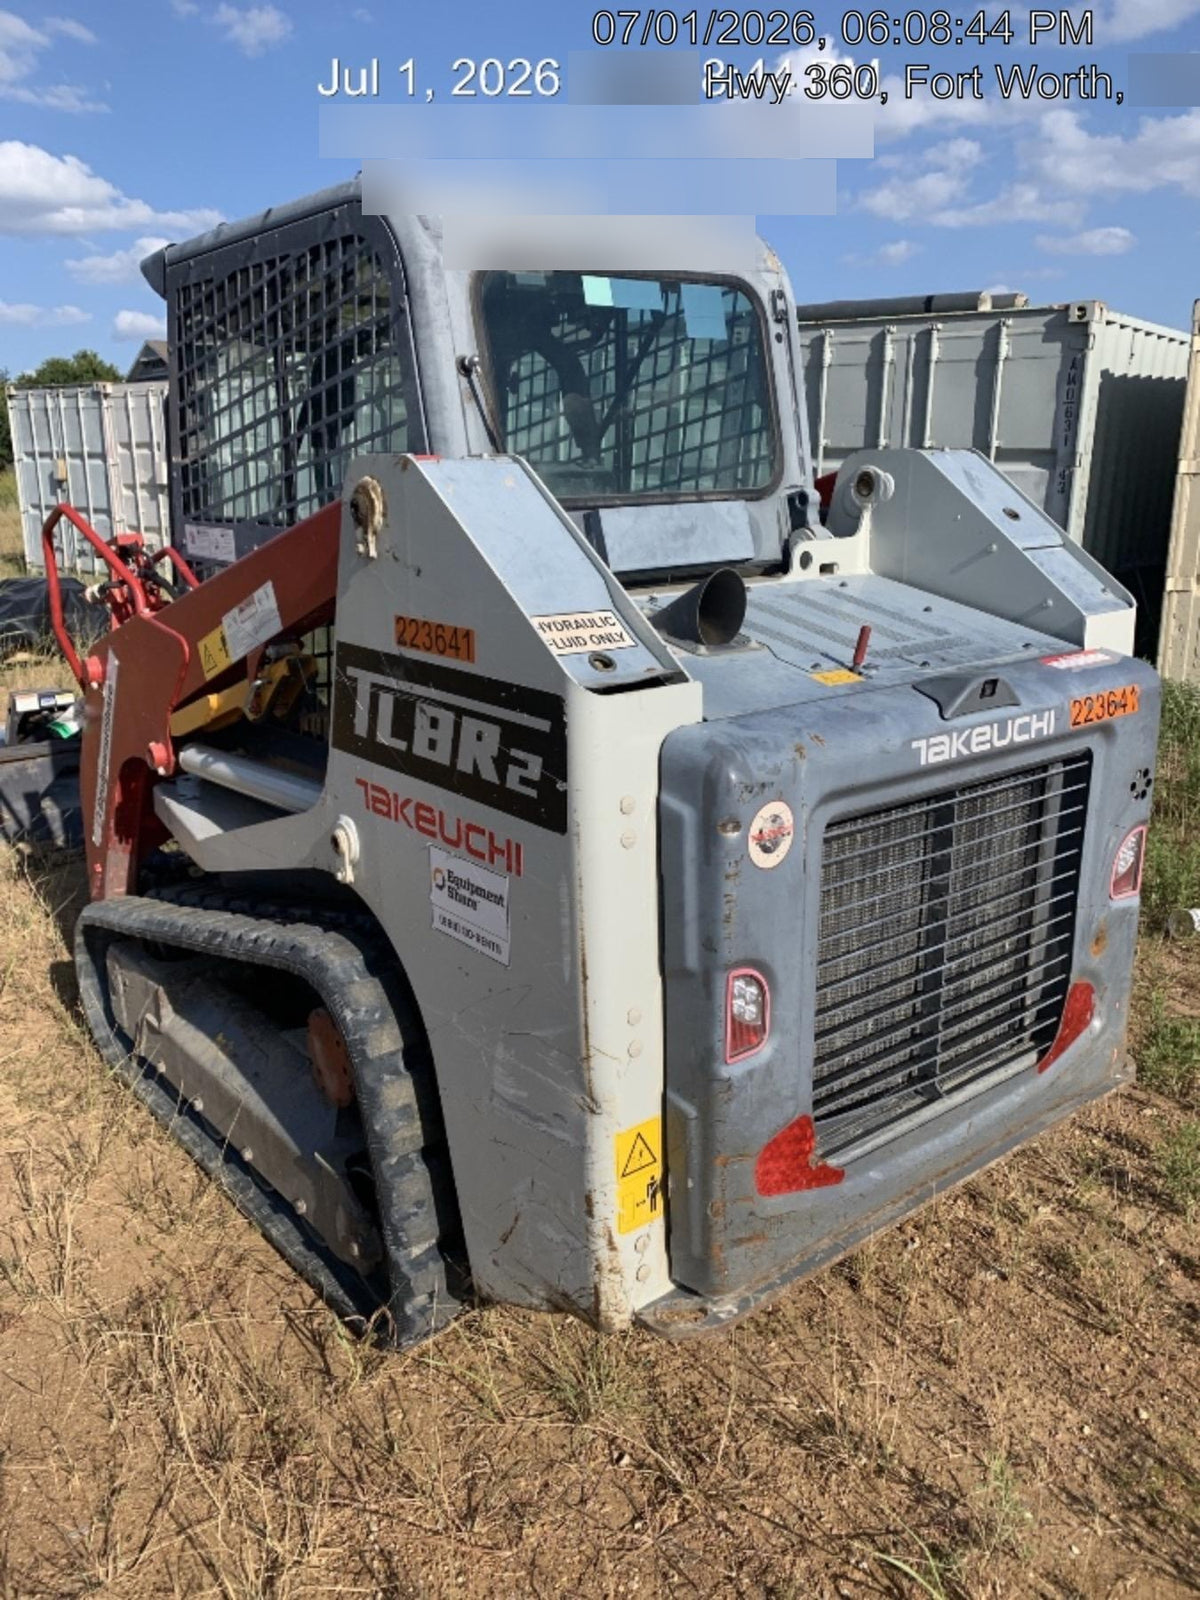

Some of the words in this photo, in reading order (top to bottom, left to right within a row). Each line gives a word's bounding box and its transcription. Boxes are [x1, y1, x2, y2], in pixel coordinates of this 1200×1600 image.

[395, 616, 475, 662] 223641
[589, 632, 626, 645] ONLY
[1071, 686, 1138, 726] 223641
[912, 710, 1055, 765] TAKEUCHI
[355, 778, 523, 877] TAKEUCHI
[447, 869, 505, 907] Equipment
[447, 885, 478, 911] Share
